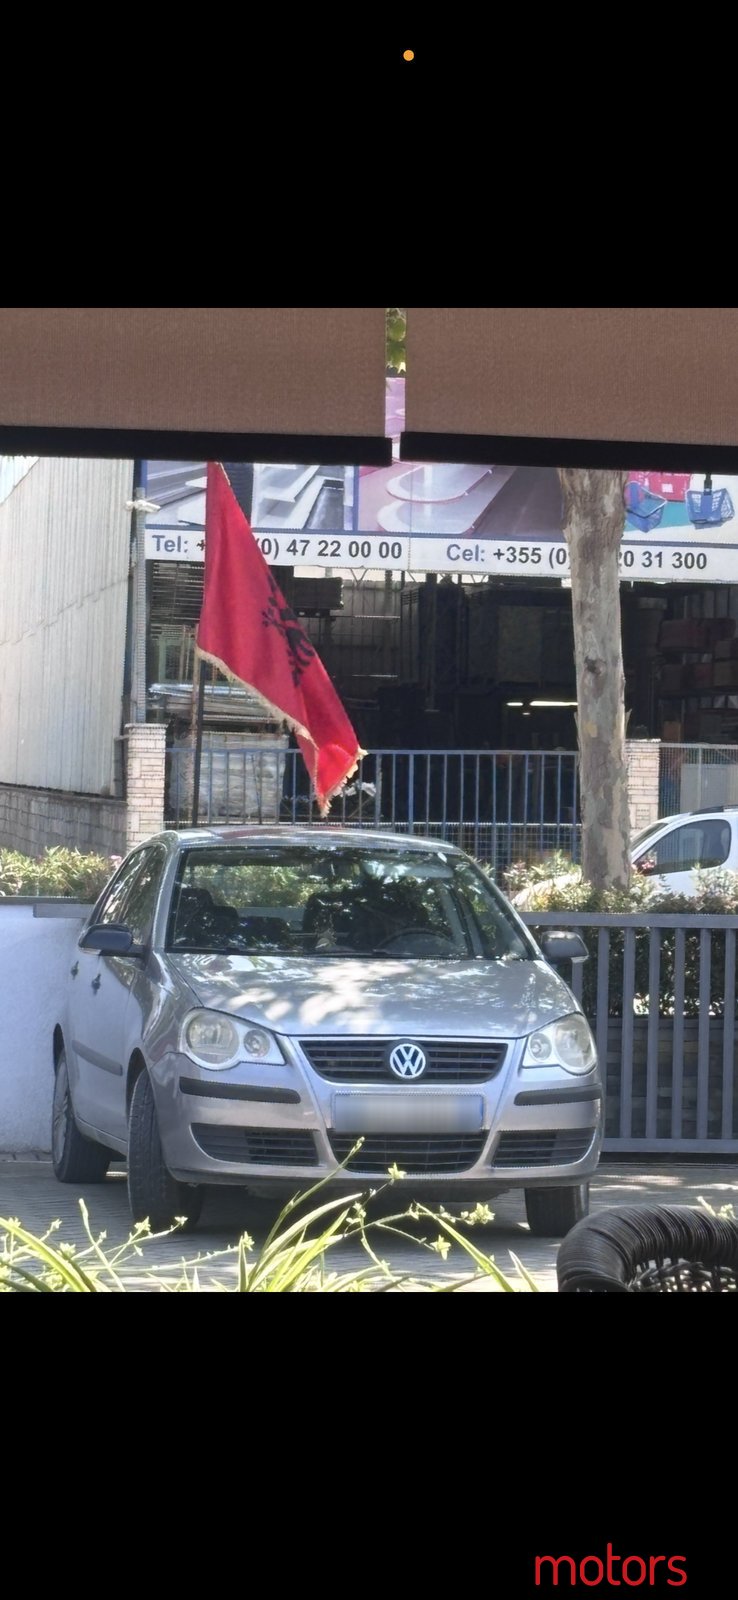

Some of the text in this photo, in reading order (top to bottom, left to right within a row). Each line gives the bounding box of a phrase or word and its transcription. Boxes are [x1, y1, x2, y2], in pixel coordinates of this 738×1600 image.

[152, 534, 188, 554] Tel:
[287, 539, 310, 557] 47
[317, 540, 341, 558] 22
[348, 541, 372, 558] 00
[378, 542, 402, 559] 00
[446, 543, 485, 562] Cel:
[493, 546, 542, 564] +355
[641, 551, 664, 568] 31
[671, 551, 708, 570] 300
